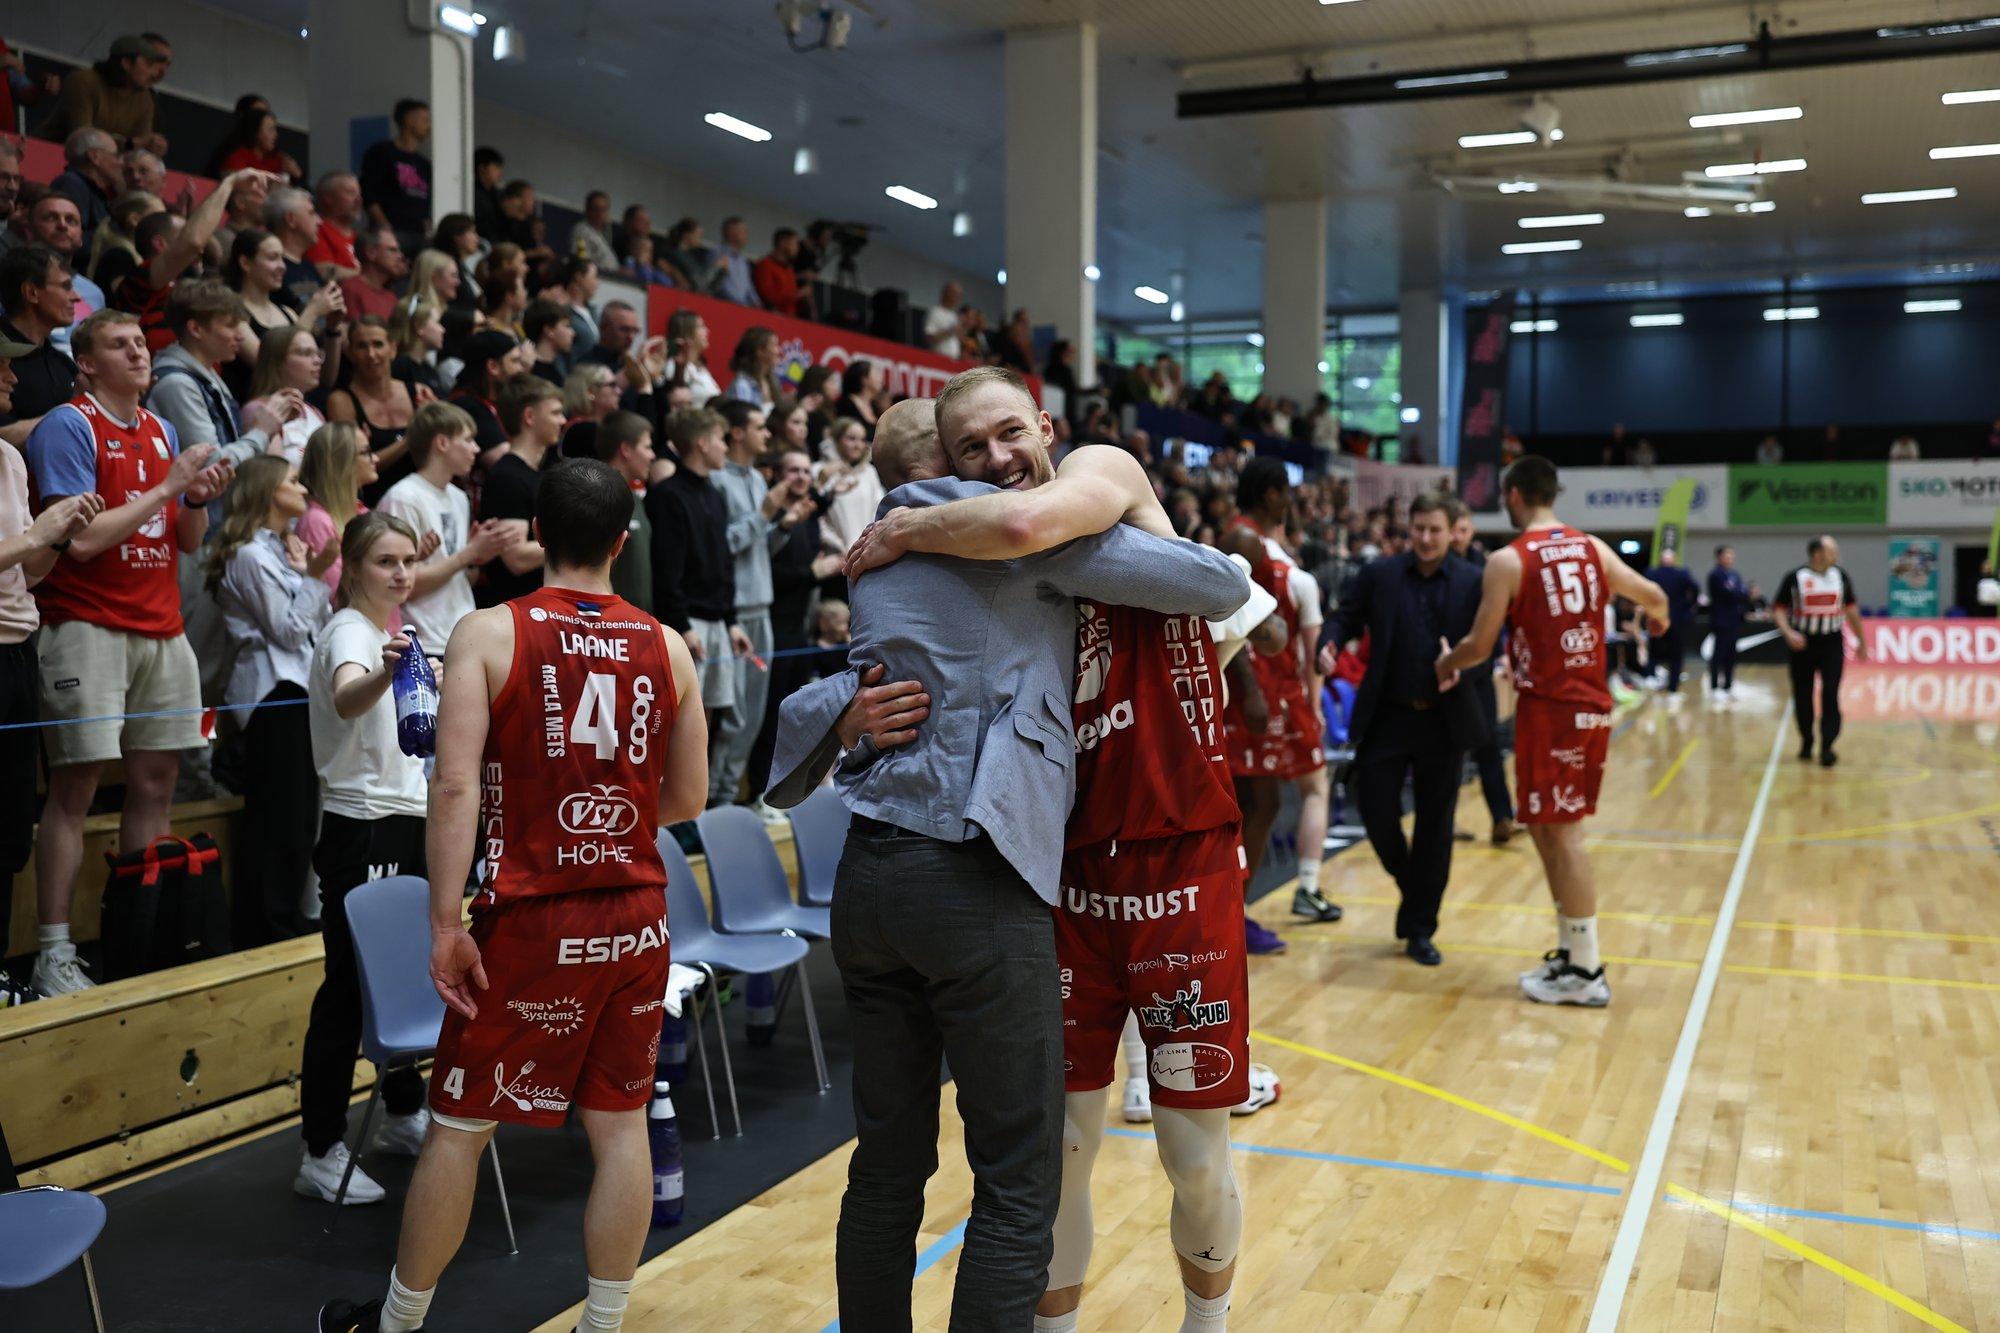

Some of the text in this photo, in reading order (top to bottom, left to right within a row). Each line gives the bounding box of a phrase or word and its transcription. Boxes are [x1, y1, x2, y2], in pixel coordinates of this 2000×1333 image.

[1764, 480, 1879, 504] Verston
[1556, 561, 1586, 615] 5
[559, 630, 630, 663] LAANE
[1874, 625, 2000, 665] NORD
[541, 664, 566, 758] RAPLA METS
[570, 670, 619, 761] 4
[628, 675, 655, 765] coop
[650, 709, 662, 735] Rapla
[557, 840, 634, 866] HÖHE
[1062, 886, 1200, 922] USTRUST
[1191, 949, 1228, 965] keskus
[521, 1010, 574, 1022] Systems
[1195, 1001, 1229, 1025] PUBI
[1195, 1049, 1228, 1060] BALTIC
[442, 1066, 466, 1100] 4
